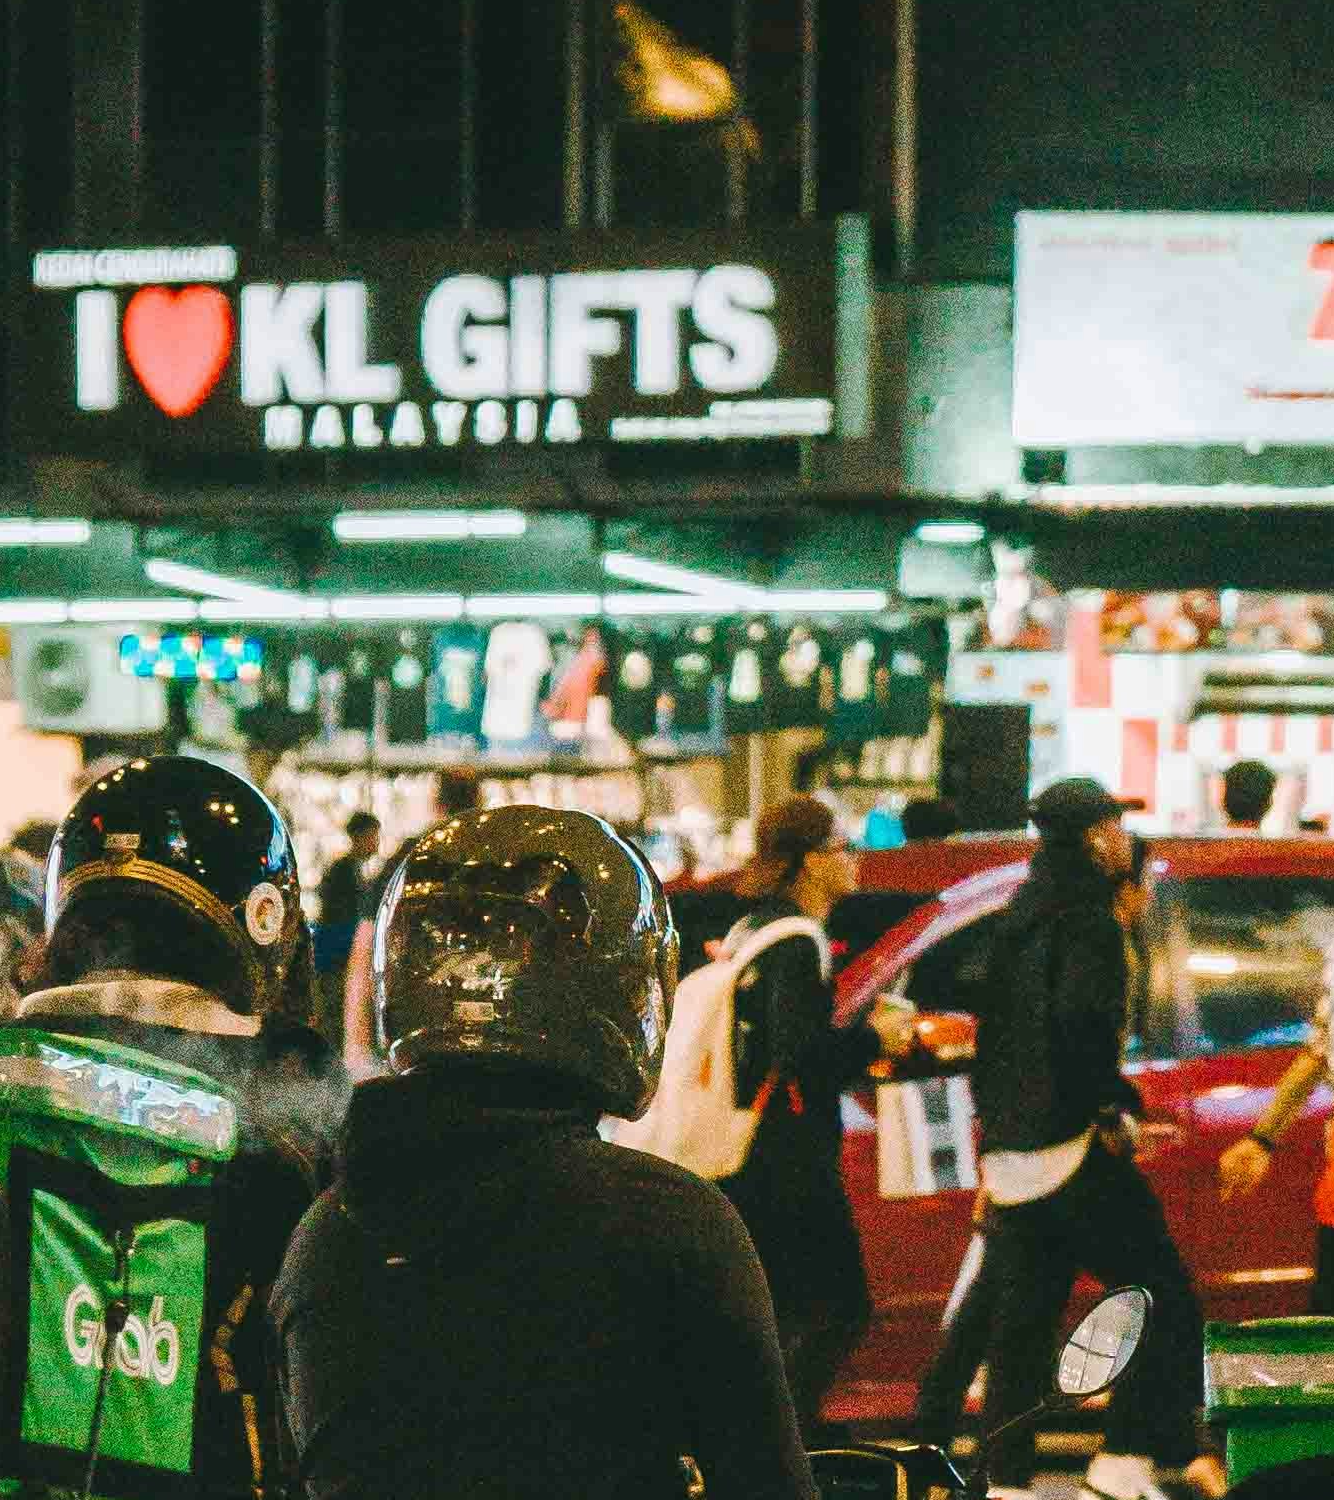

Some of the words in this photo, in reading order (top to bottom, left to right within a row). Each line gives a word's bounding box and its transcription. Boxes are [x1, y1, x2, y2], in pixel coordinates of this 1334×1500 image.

[76, 289, 122, 411] I
[239, 281, 403, 406] KL
[420, 262, 782, 401] GIFTS
[264, 399, 582, 450] MALAYSIA
